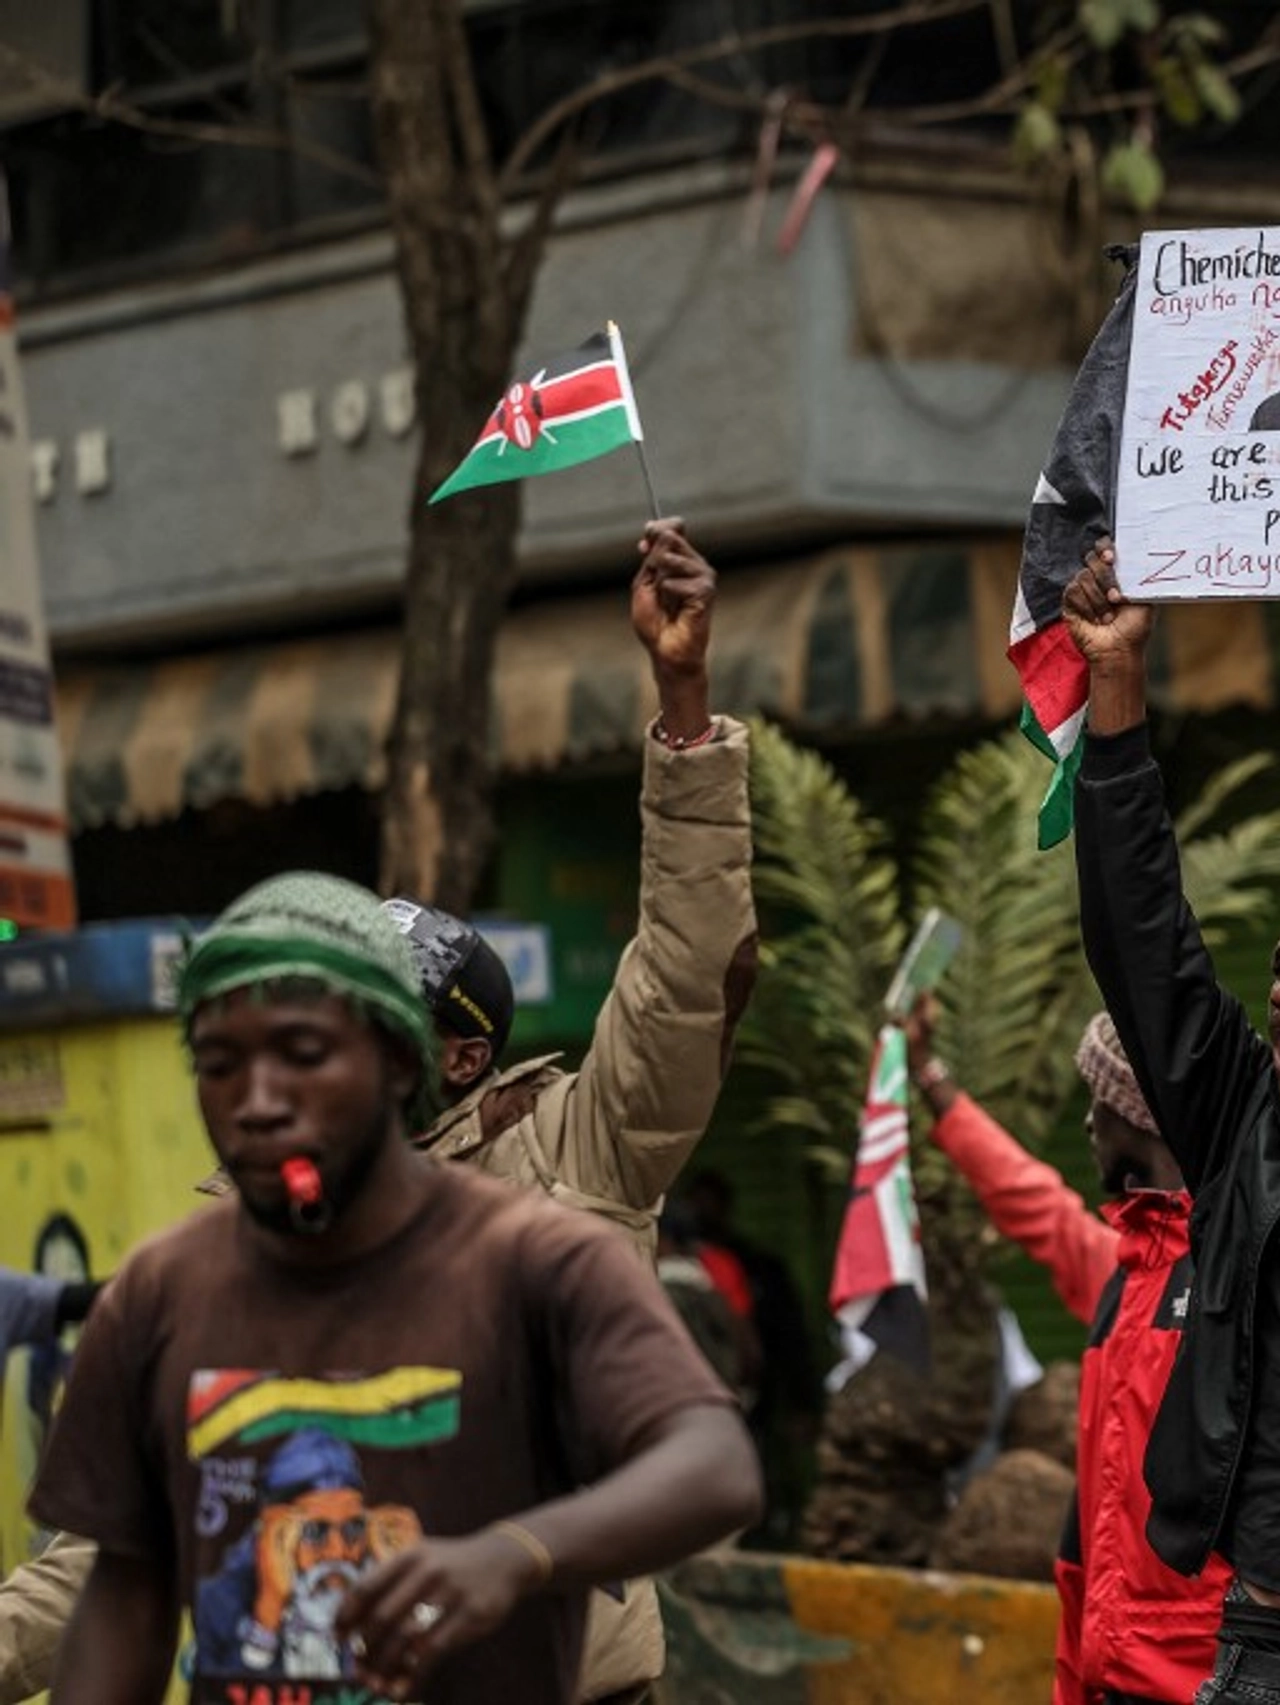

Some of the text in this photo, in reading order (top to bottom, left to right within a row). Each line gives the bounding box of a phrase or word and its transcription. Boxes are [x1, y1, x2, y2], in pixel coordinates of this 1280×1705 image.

[1137, 445, 1184, 478] We
[1211, 442, 1267, 468] are
[1207, 473, 1274, 503] this
